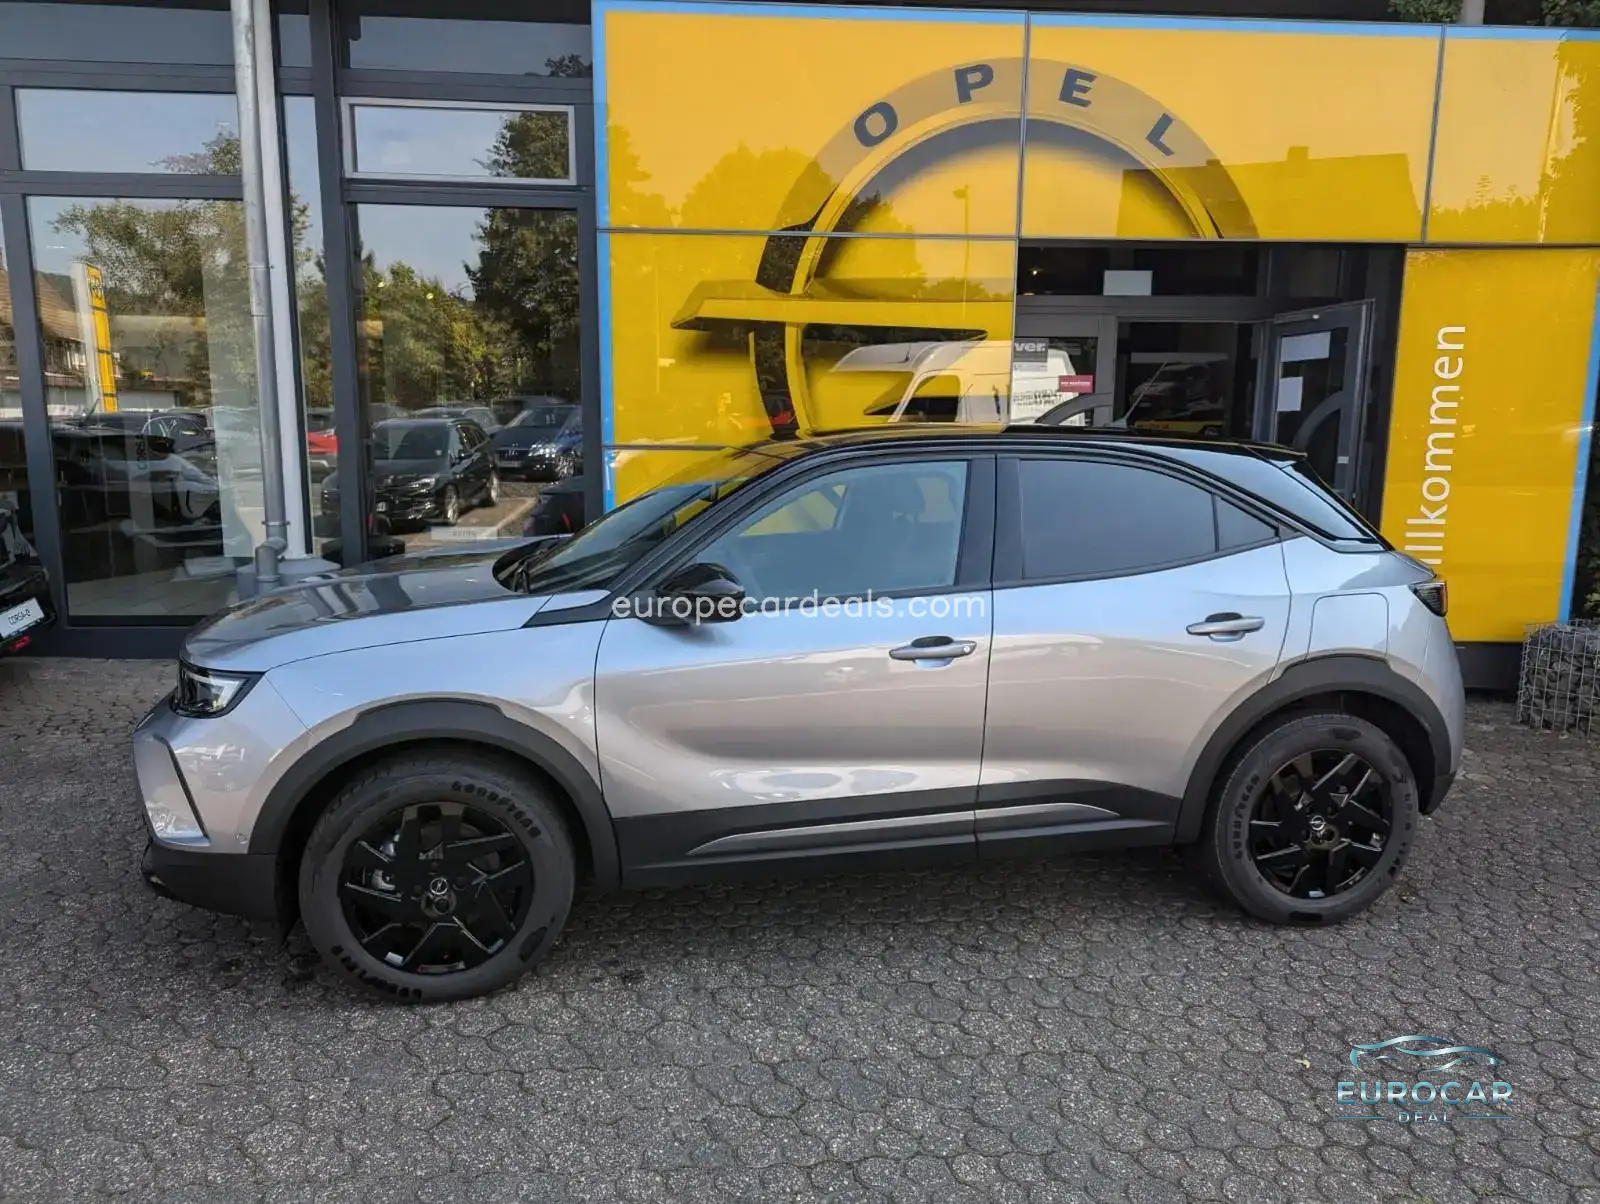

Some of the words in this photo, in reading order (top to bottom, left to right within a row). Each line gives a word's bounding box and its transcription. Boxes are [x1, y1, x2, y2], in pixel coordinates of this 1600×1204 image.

[853, 64, 1175, 157] OPEL
[1014, 342, 1046, 352] ver.
[1404, 326, 1466, 565] illkommen
